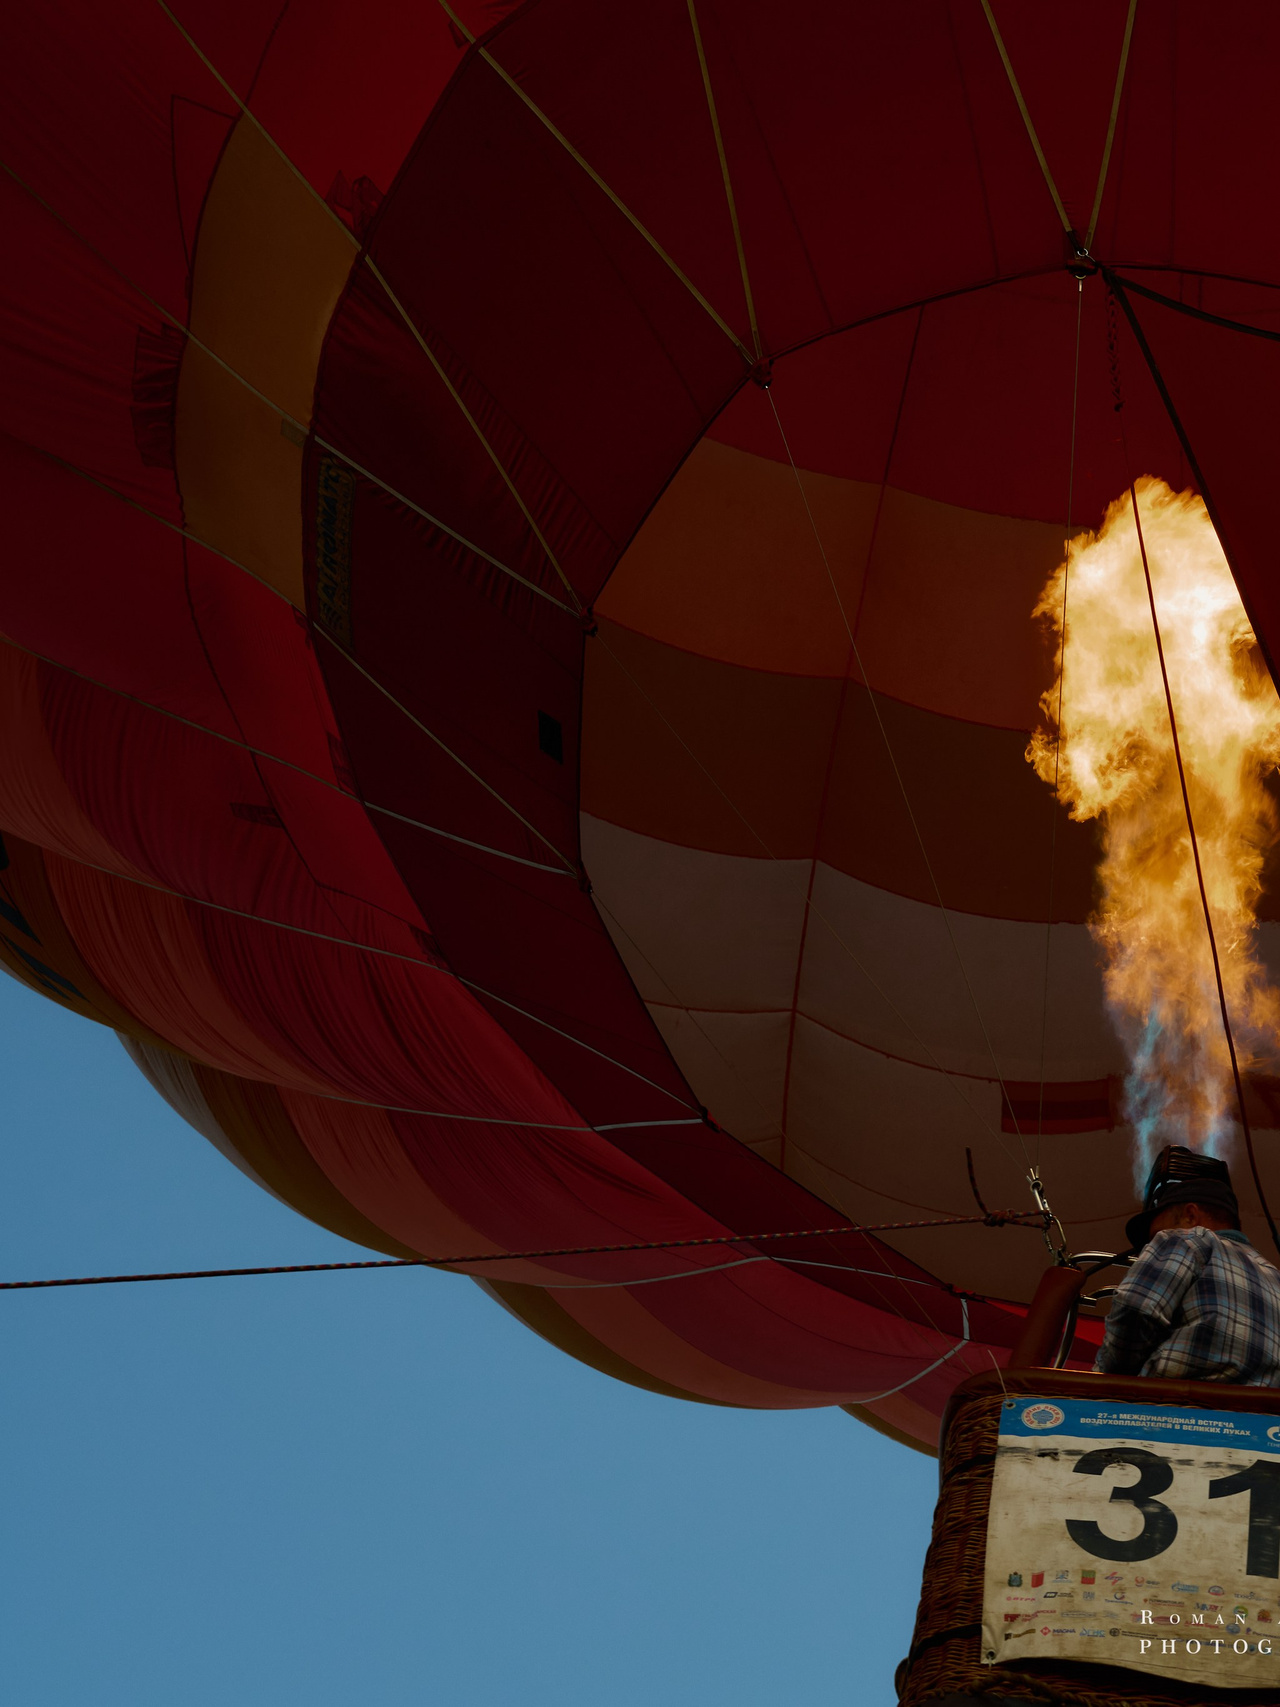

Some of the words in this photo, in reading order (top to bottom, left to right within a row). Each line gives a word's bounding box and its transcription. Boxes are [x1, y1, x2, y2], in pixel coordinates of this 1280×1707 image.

[1079, 1417, 1173, 1430] ВОЗДУХОПЛАВАТЕЛЕЙ
[1182, 1424, 1221, 1434] ВЕЛИКИХ
[1222, 1428, 1251, 1436] ЛУКАХ
[1119, 1413, 1196, 1425] МЕЖДУНАРОДНАЯ
[1198, 1419, 1235, 1428] ВСТРЕЧА
